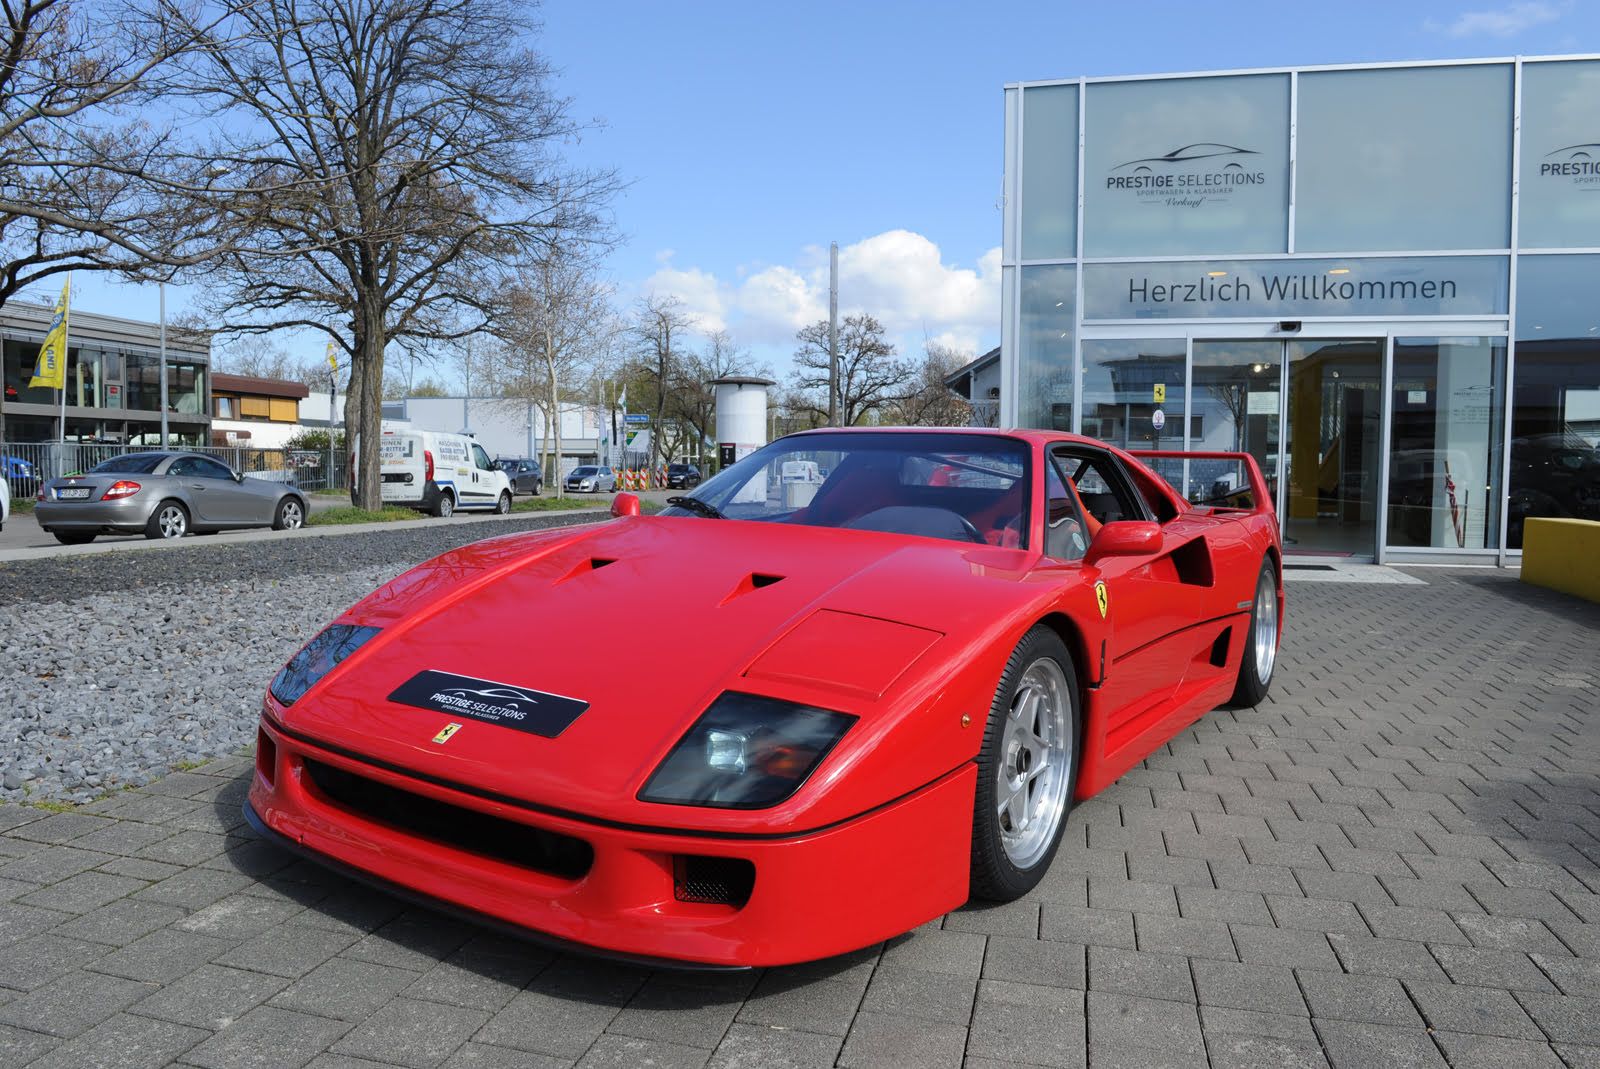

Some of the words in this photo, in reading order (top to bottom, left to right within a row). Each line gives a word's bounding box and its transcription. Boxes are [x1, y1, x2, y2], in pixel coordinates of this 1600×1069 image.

[1107, 175, 1174, 189] PRESTIGE
[1177, 172, 1265, 187] SELECTIONS
[1194, 187, 1233, 195] KLASSIKER
[1165, 196, 1206, 208] Verkauf
[1129, 277, 1251, 302] Herzlich
[1262, 275, 1457, 300] Willkommen
[430, 693, 473, 708] PRESTIGE
[470, 702, 527, 719] SELECTIONS
